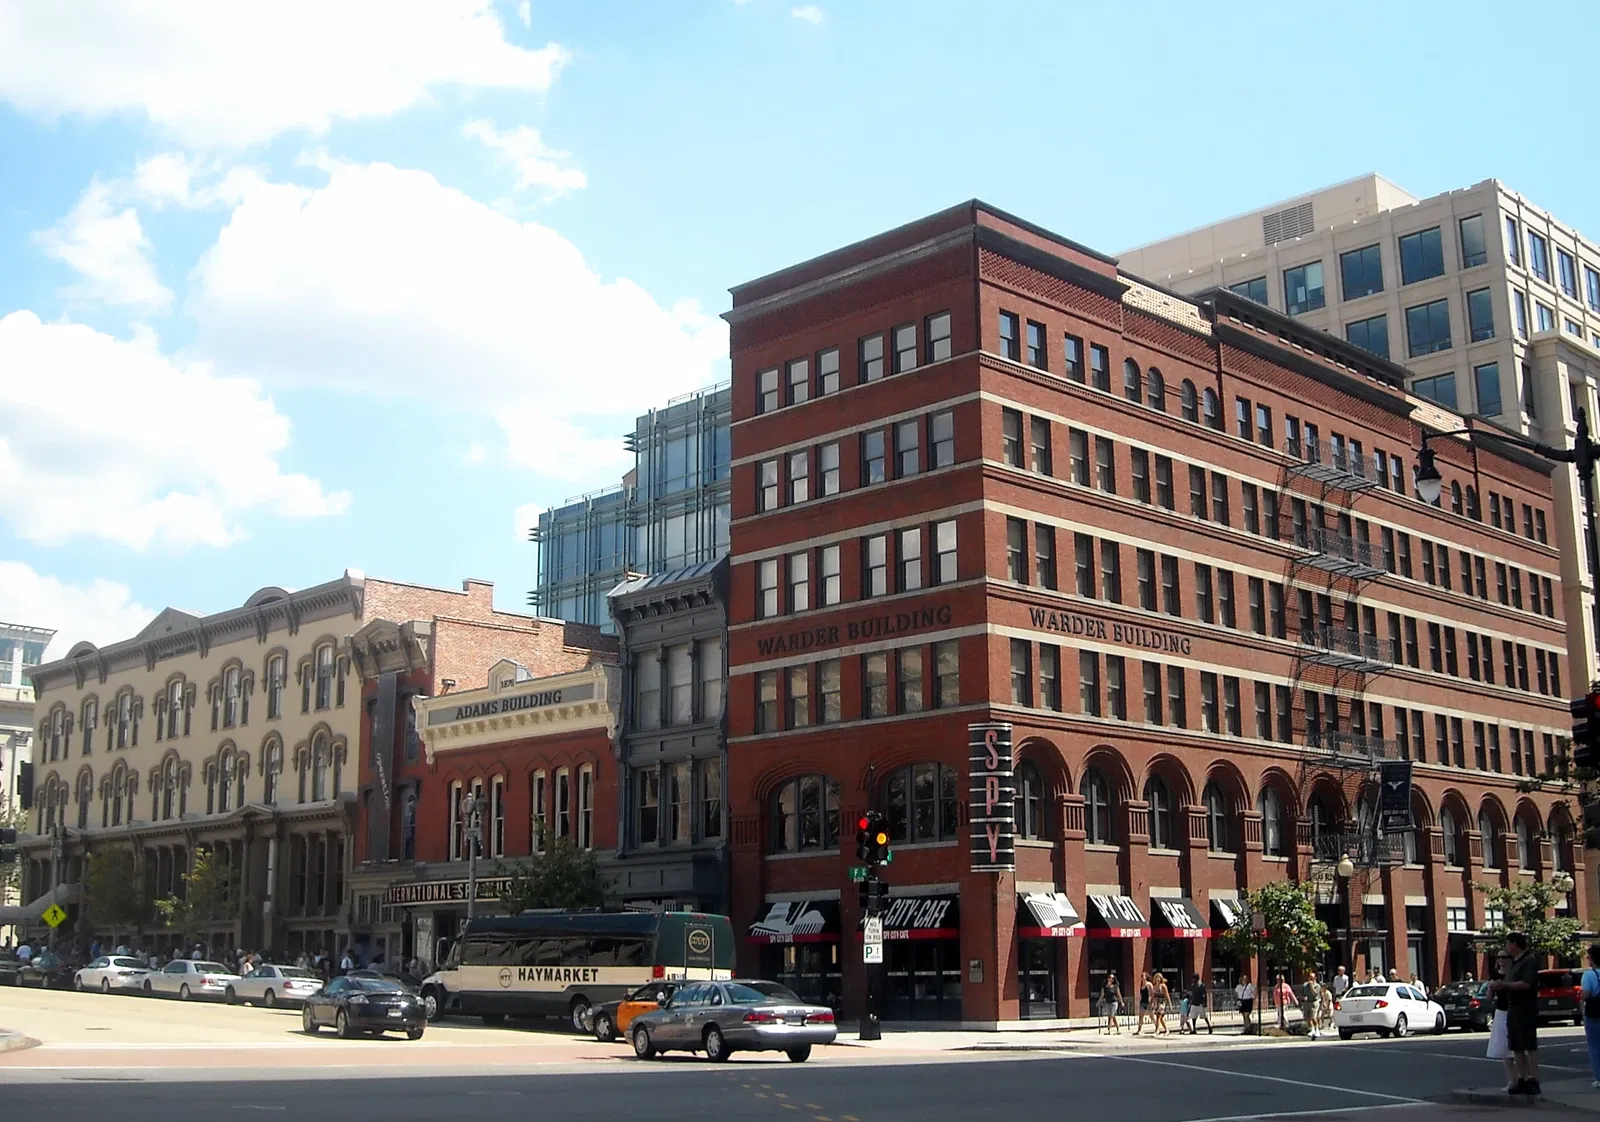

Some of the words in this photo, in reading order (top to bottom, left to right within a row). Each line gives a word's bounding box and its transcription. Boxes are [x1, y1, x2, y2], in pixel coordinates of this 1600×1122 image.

[757, 626, 840, 656] WARDER
[847, 605, 952, 640] BUILDING
[1029, 607, 1107, 640] WARDER
[1113, 623, 1191, 655] BUILDING
[456, 700, 498, 720] ADAMS
[501, 690, 562, 712] BUILDING
[985, 730, 999, 863] SPY
[385, 884, 452, 903] INTERNATIONAL
[884, 898, 920, 927] CITY
[913, 899, 951, 928] CAFE
[1089, 894, 1119, 919] SPY
[1112, 895, 1146, 922] CITY
[1161, 901, 1198, 929] CAFE
[777, 935, 785, 943] CITY
[890, 930, 899, 939] CITY
[1058, 928, 1066, 936] CITY
[865, 946, 873, 959] P
[518, 967, 599, 982] HAYMARKET
